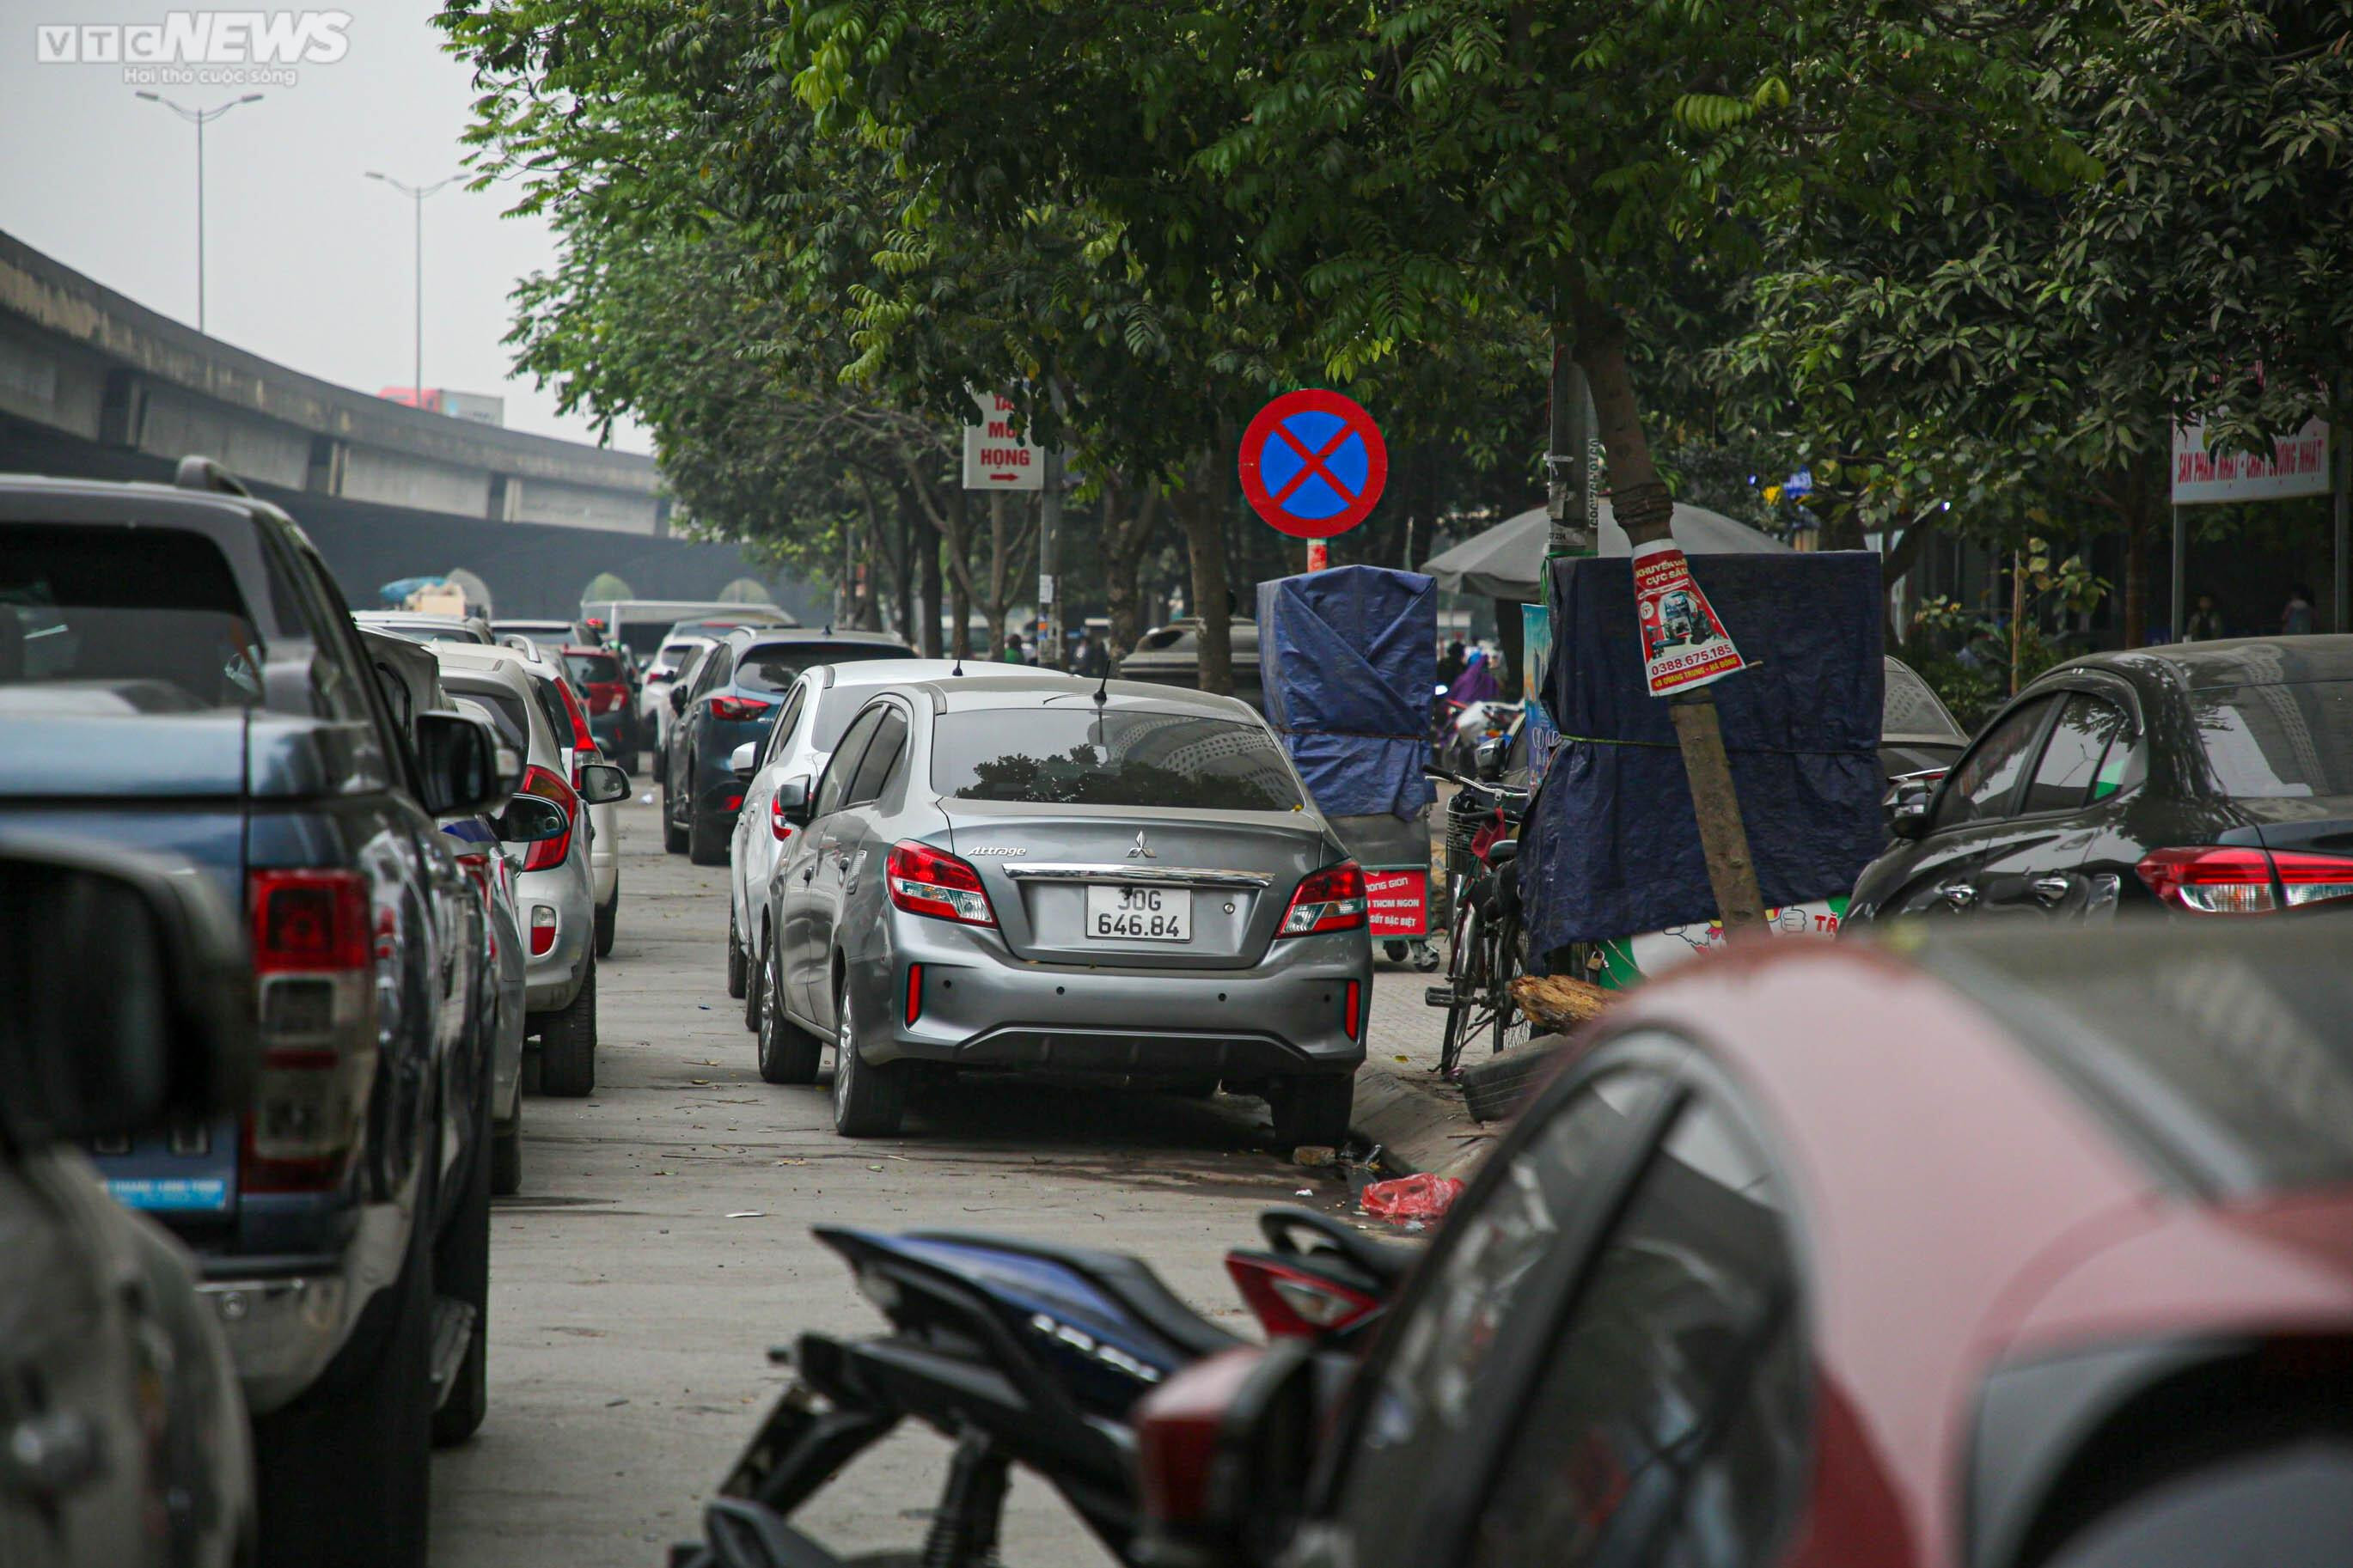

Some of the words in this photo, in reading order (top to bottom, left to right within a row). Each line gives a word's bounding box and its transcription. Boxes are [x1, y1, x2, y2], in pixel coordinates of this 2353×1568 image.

[981, 448, 1031, 468] HỌNG
[1651, 644, 1733, 675] 0388.675.185
[968, 845, 1027, 857] Attrage
[1097, 912, 1180, 937] 646.84
